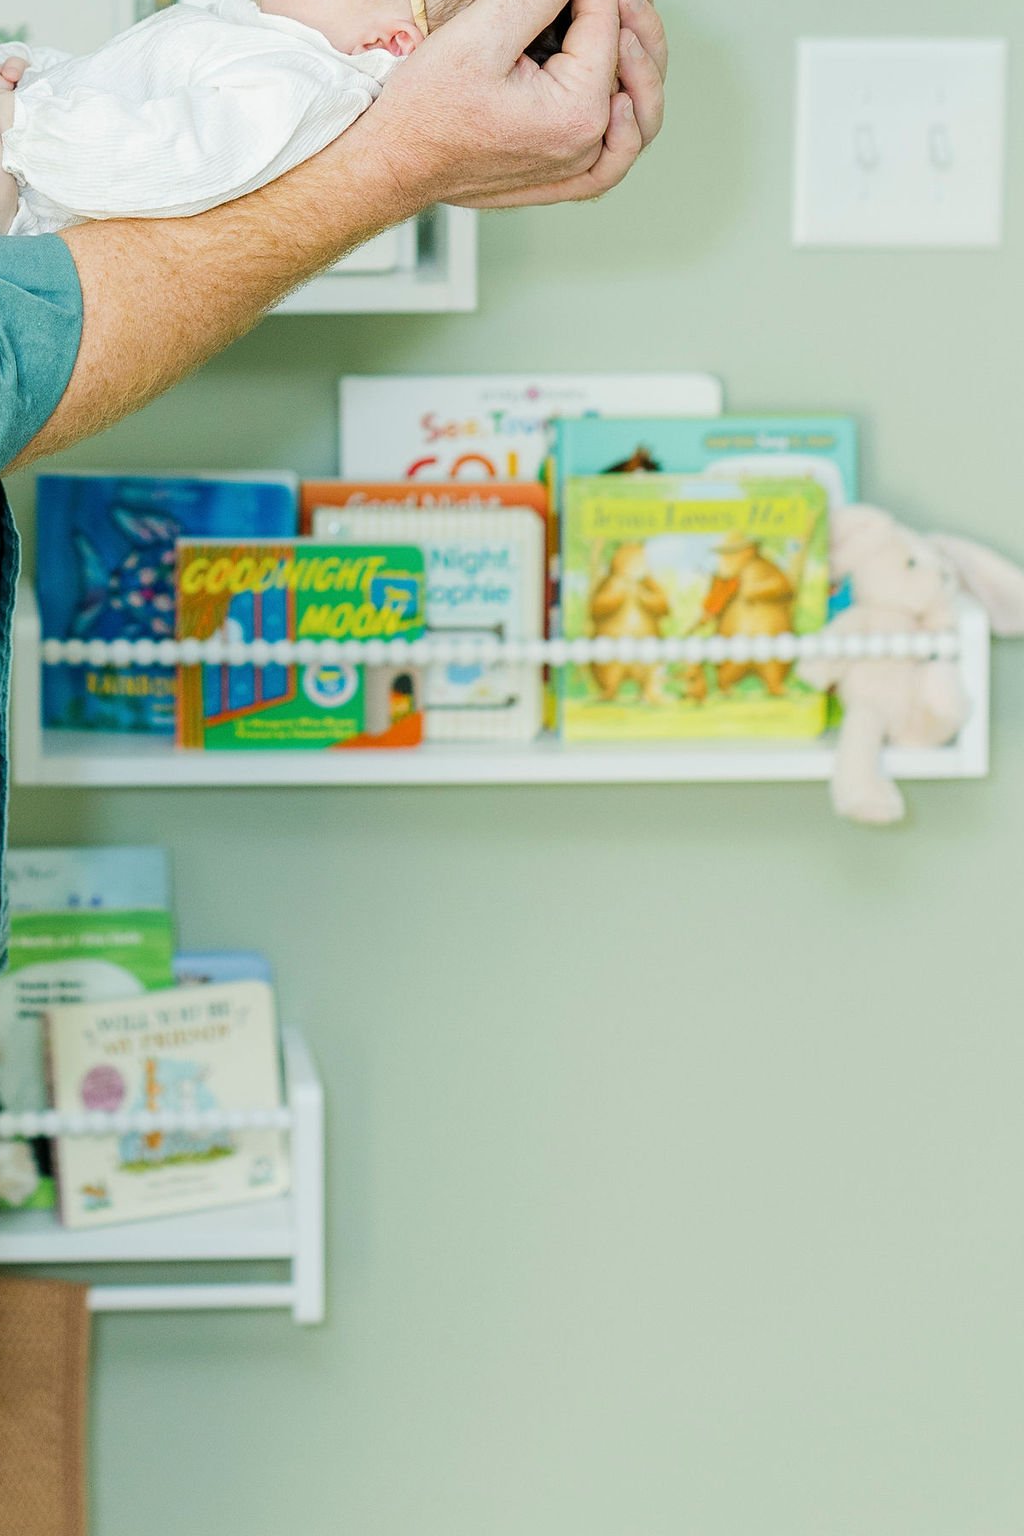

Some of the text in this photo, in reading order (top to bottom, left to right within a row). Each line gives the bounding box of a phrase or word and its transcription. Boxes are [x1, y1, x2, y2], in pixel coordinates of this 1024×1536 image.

[180, 555, 387, 596] GOODNIGHT
[427, 577, 512, 607] ophie
[297, 600, 403, 639] MOON
